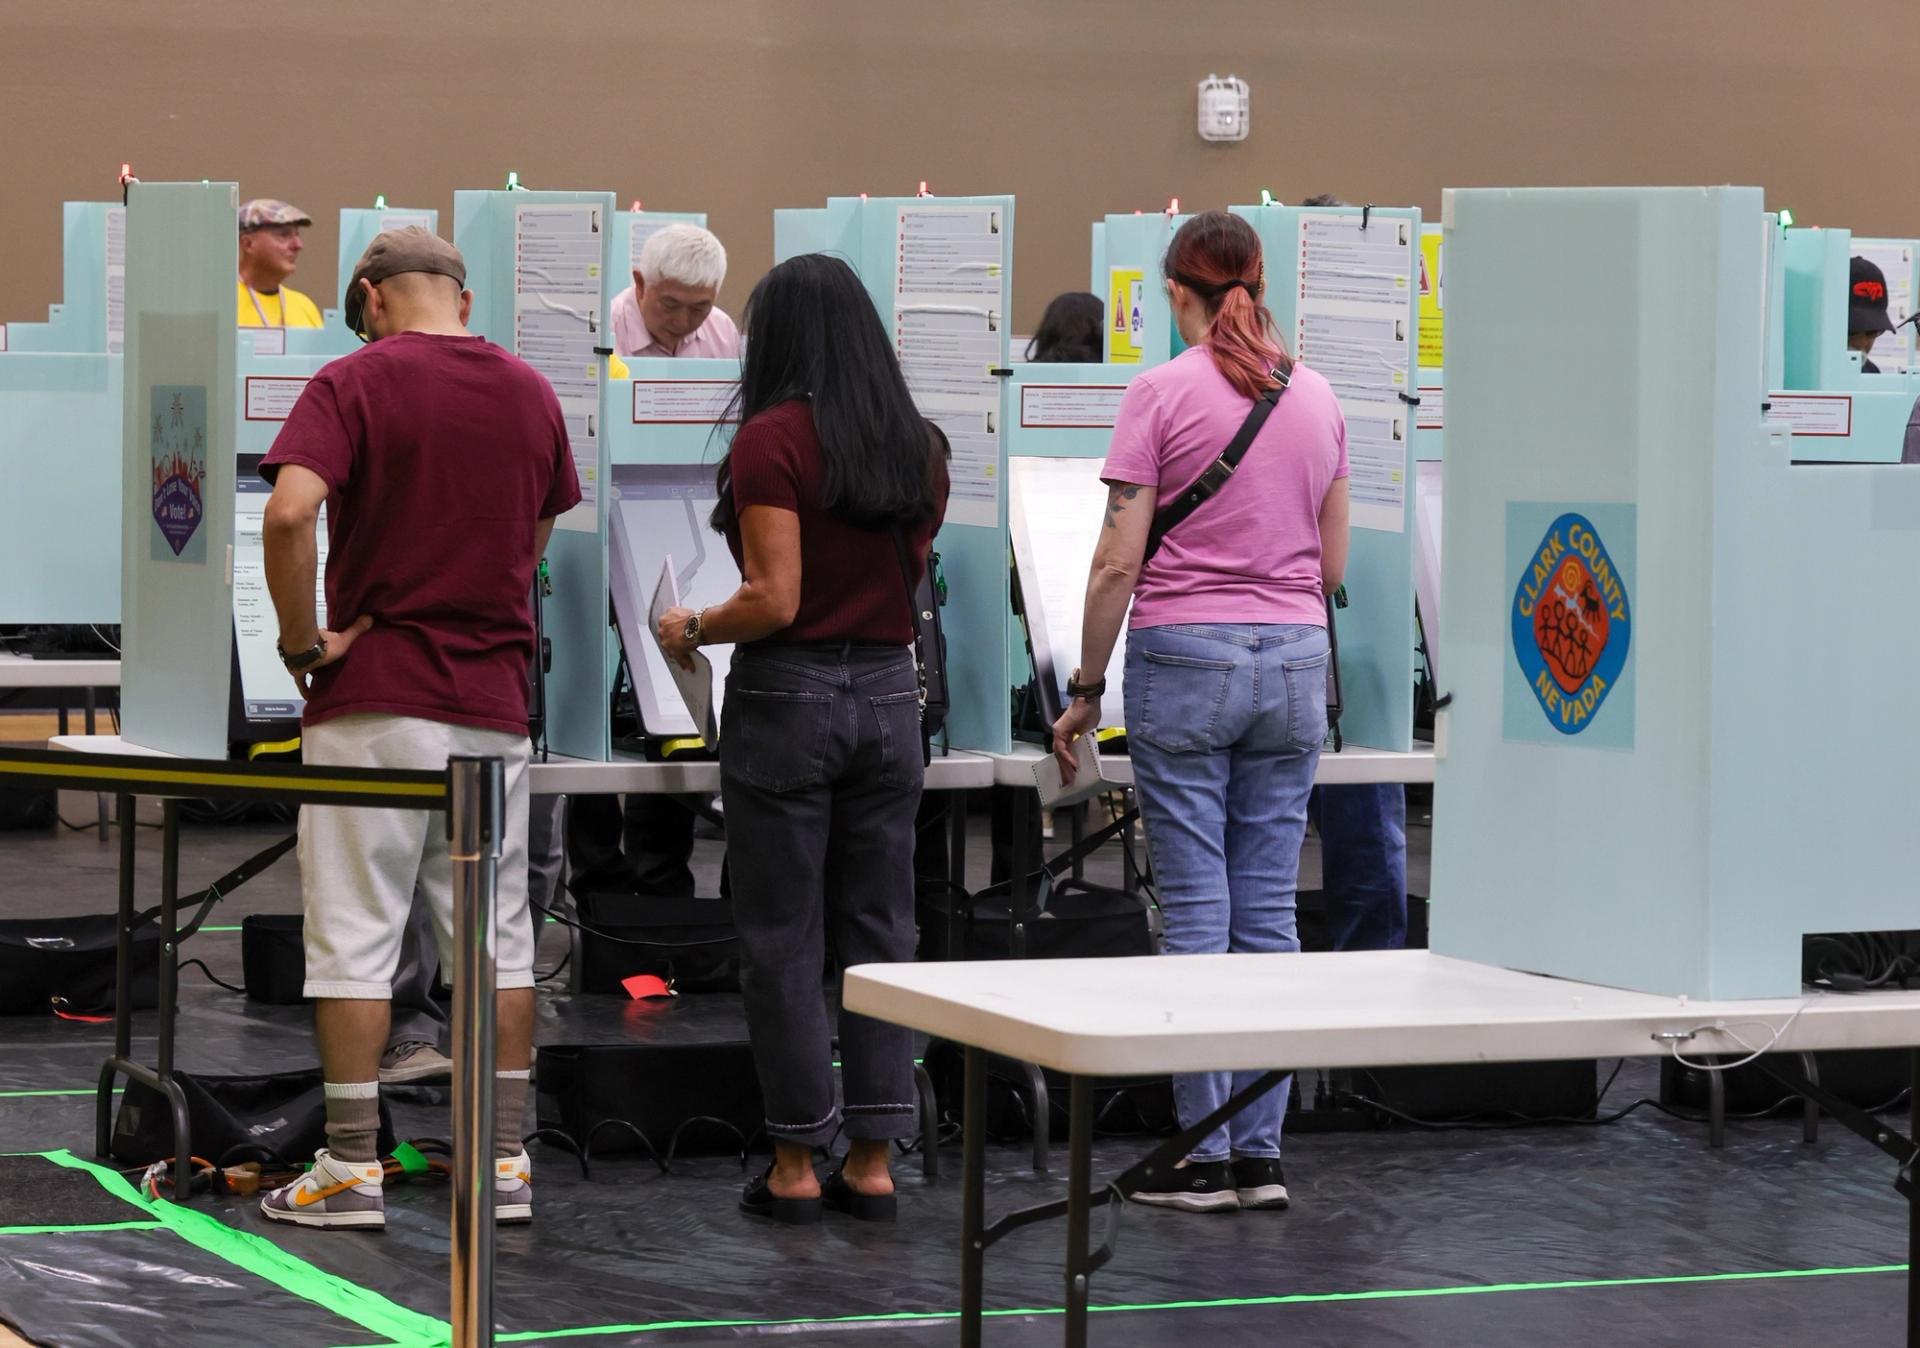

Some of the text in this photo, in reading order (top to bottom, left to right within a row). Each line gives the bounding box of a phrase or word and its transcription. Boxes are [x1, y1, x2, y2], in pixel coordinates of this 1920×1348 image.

[169, 503, 186, 520] Vote!
[1519, 523, 1626, 621] CLARK COUNTY
[1536, 669, 1607, 725] NEVADA
